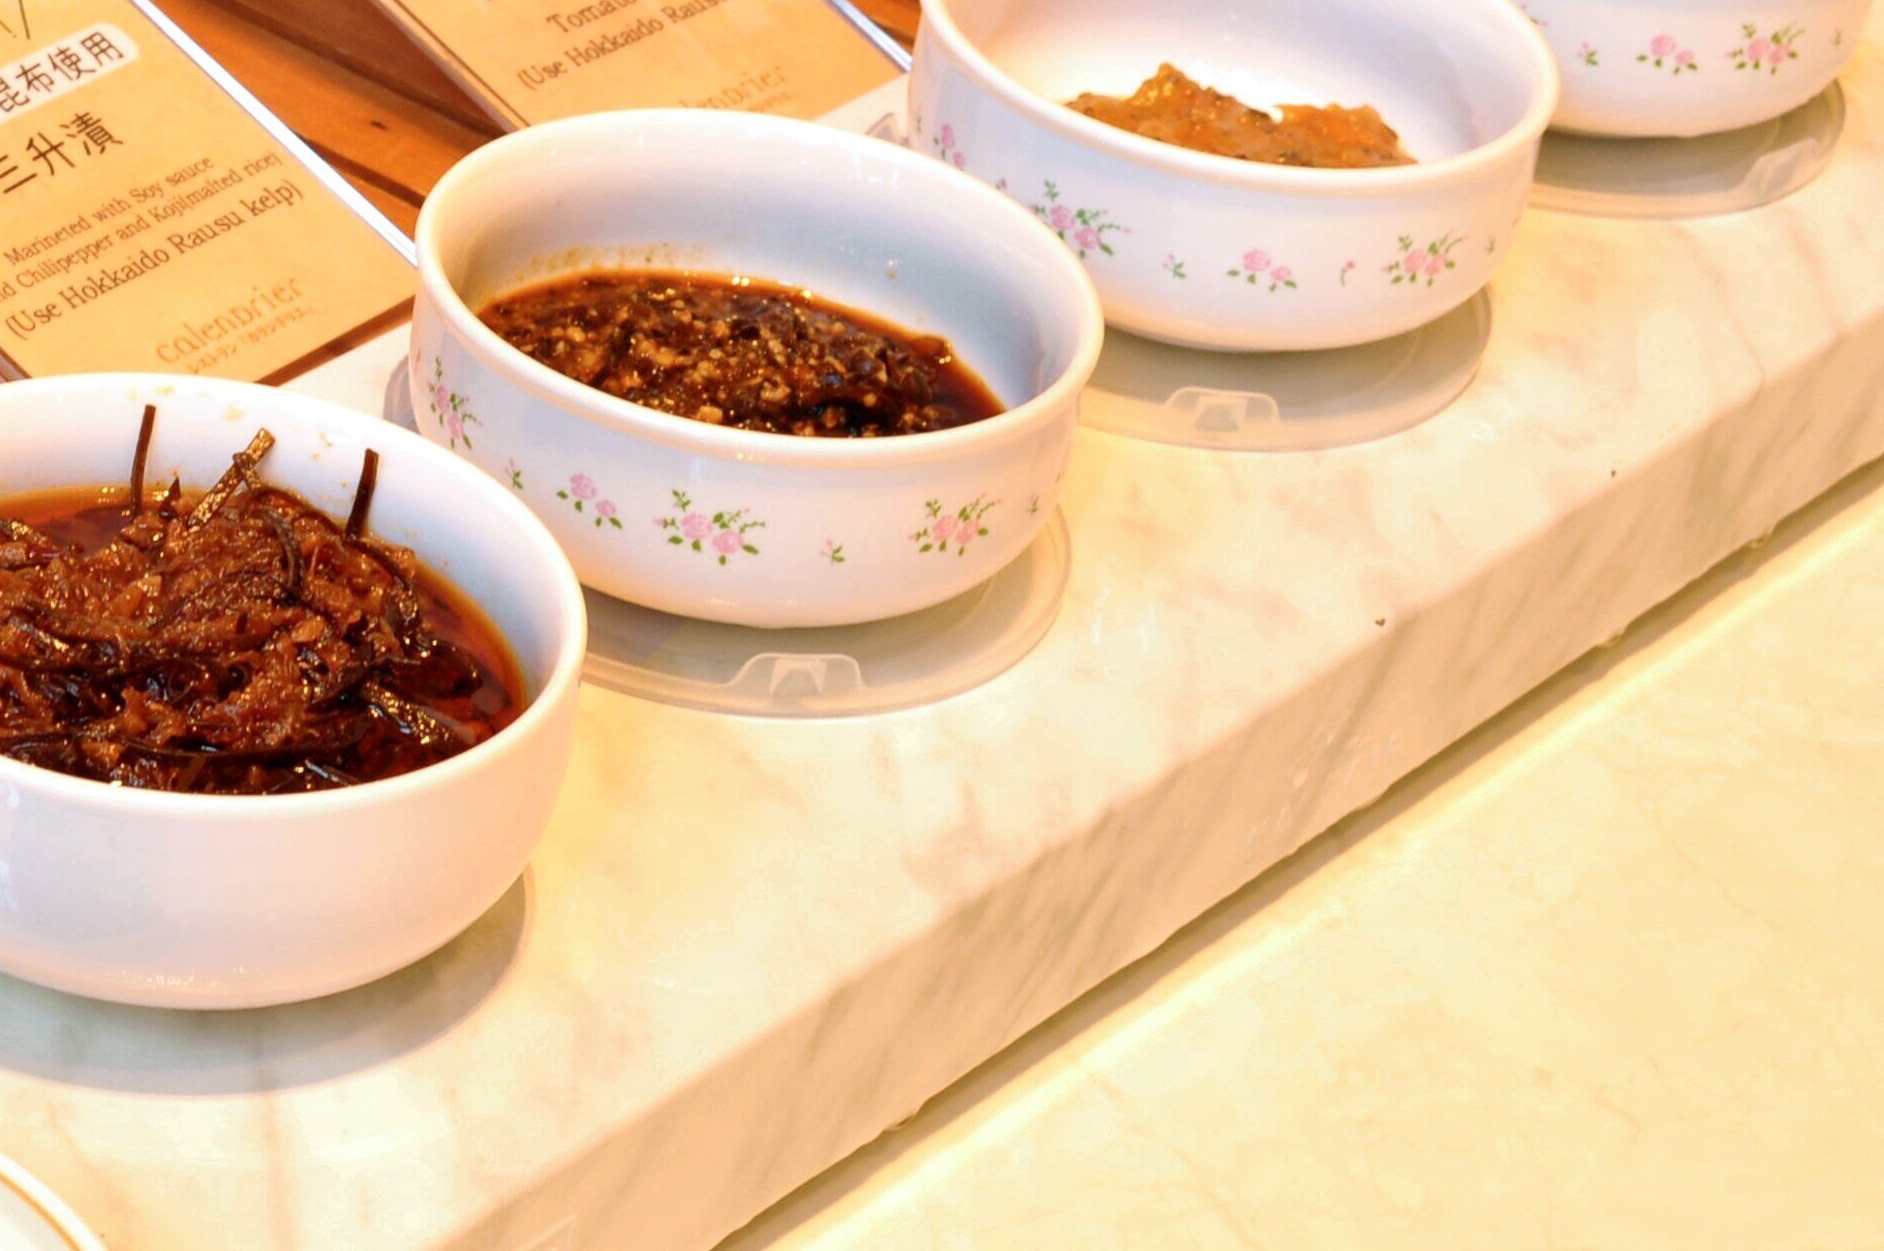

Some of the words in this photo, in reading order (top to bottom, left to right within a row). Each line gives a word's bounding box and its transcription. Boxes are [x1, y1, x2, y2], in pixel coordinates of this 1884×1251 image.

[517, 58, 568, 91] (Use
[564, 17, 665, 68] Hokkaido
[3, 216, 92, 267] Marineted
[92, 195, 131, 223] with
[130, 182, 164, 204] Soy
[166, 156, 214, 186] sauce
[116, 215, 151, 241] and
[6, 299, 62, 340] (Use
[58, 247, 170, 310] Hokkaido
[168, 209, 244, 254] Rausu
[240, 179, 304, 217] kelp)
